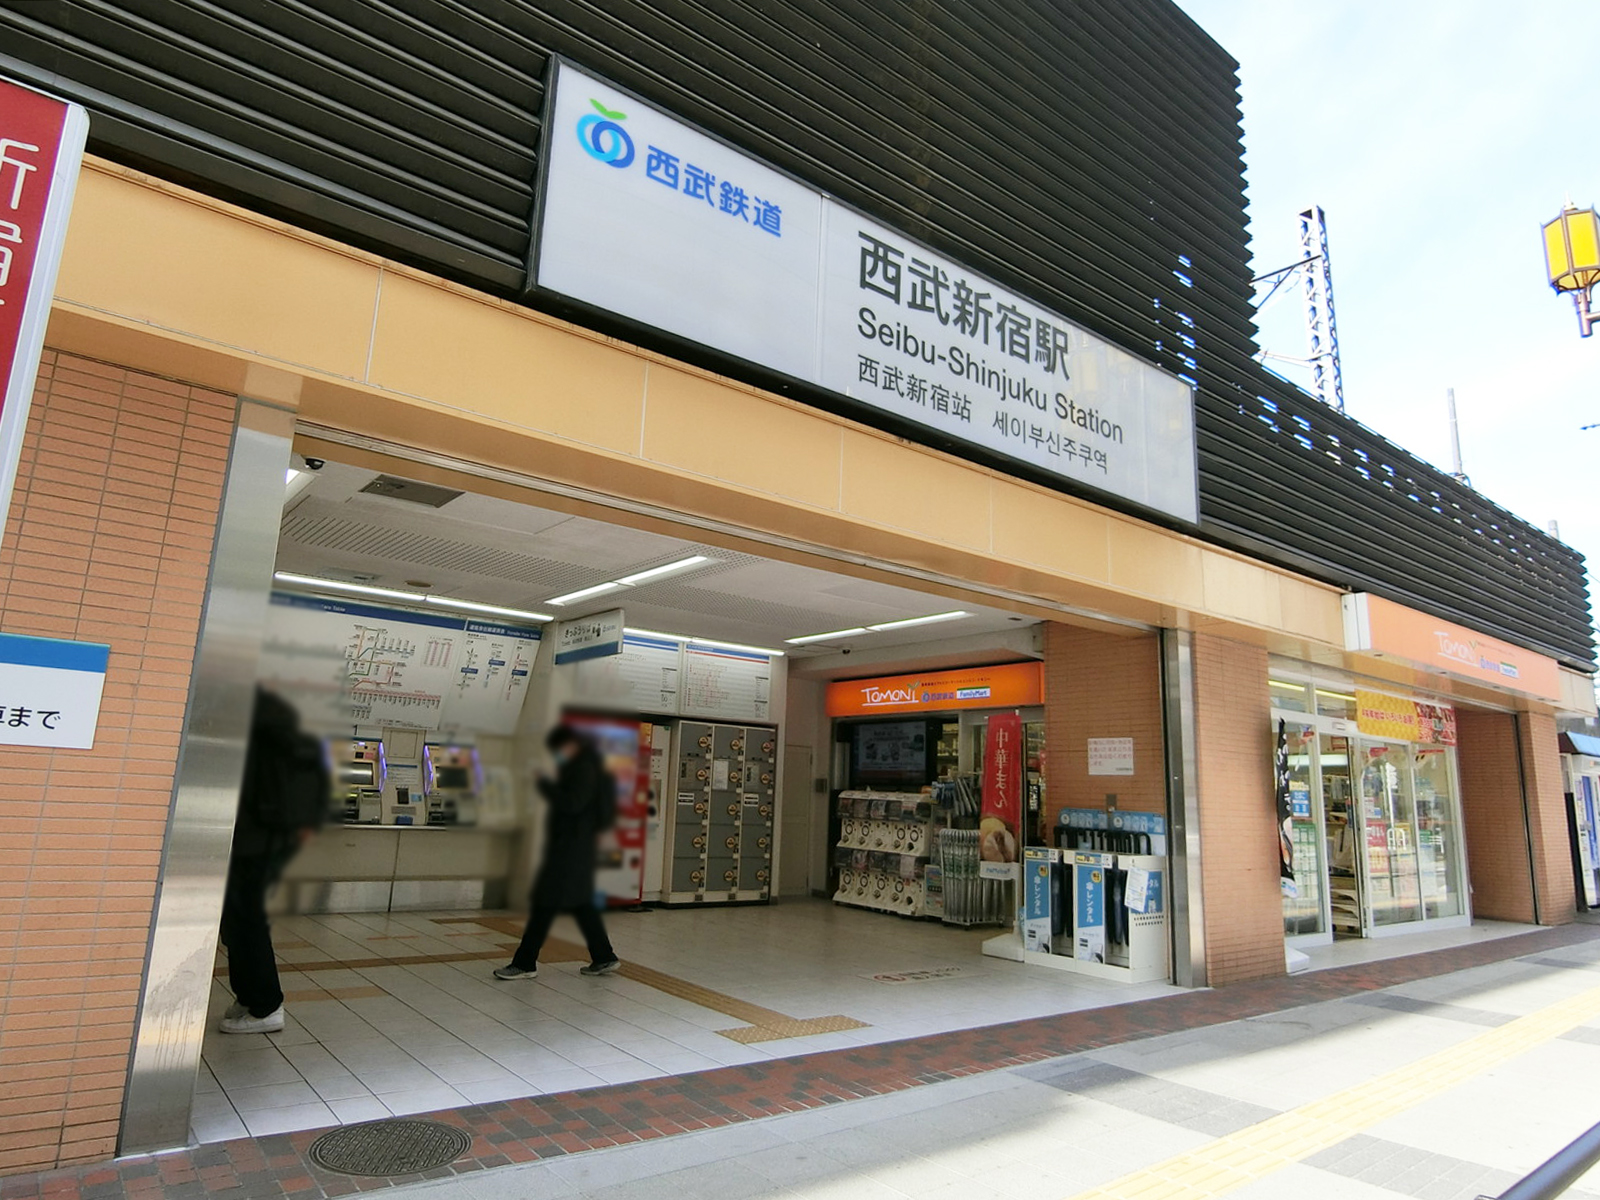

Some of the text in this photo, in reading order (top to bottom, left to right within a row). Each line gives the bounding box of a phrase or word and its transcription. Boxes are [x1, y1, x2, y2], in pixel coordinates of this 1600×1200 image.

[645, 144, 782, 239] 西武鉄道
[857, 230, 1071, 382] 西武新宿駅
[857, 306, 1124, 445] Seibu-Shinjuku Station
[857, 353, 972, 424] 西武新宿站
[991, 409, 1109, 475] 세이부신주쿠역
[861, 685, 919, 706] TOMONI
[1085, 881, 1094, 923] 傘レンタル
